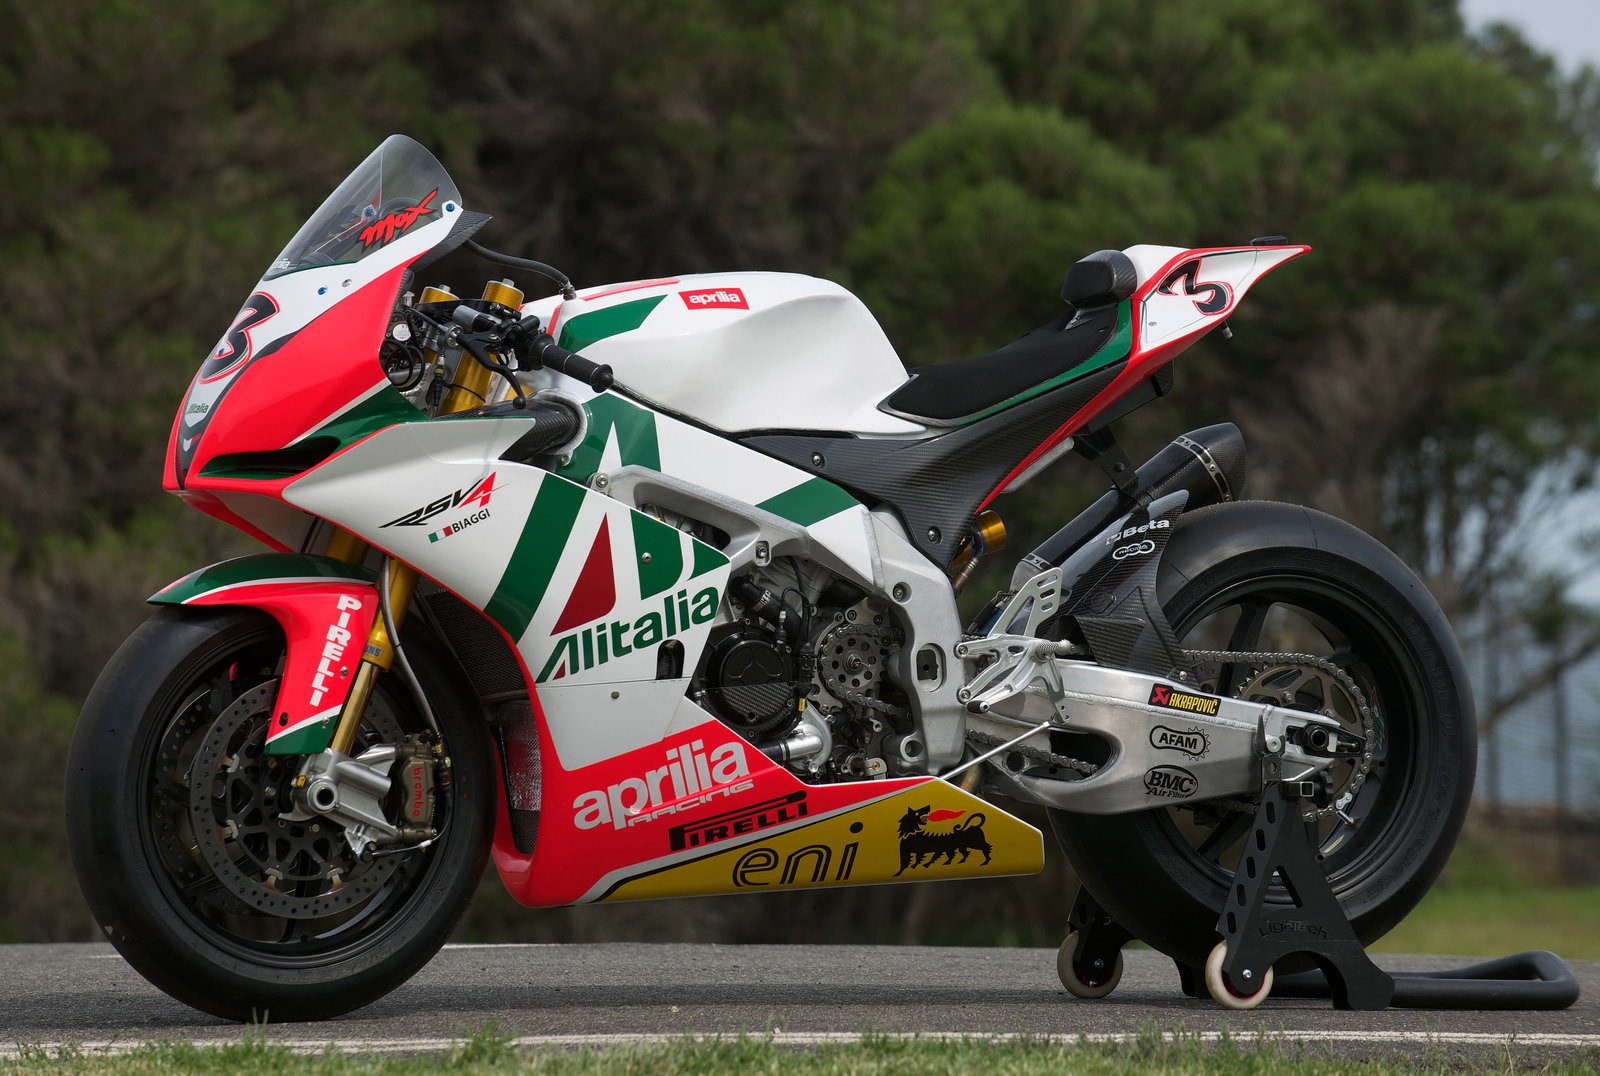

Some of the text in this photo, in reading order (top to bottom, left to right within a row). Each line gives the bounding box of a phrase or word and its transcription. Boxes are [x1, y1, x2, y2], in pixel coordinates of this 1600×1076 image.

[688, 291, 741, 305] aprilia
[1156, 257, 1234, 316] 3
[199, 291, 281, 384] 3
[452, 508, 491, 533] BIAGGI
[1122, 519, 1170, 538] Beta
[309, 593, 362, 707] PIRELLI
[535, 586, 720, 684] Alitalia
[1158, 732, 1198, 750] AFAM
[412, 767, 425, 817] brembo
[573, 738, 750, 830] aprilia
[627, 779, 755, 827] RACING
[1145, 787, 1168, 797] Air
[1147, 770, 1194, 793] BMC
[668, 789, 808, 851] PIRELLI
[732, 821, 865, 888] eni
